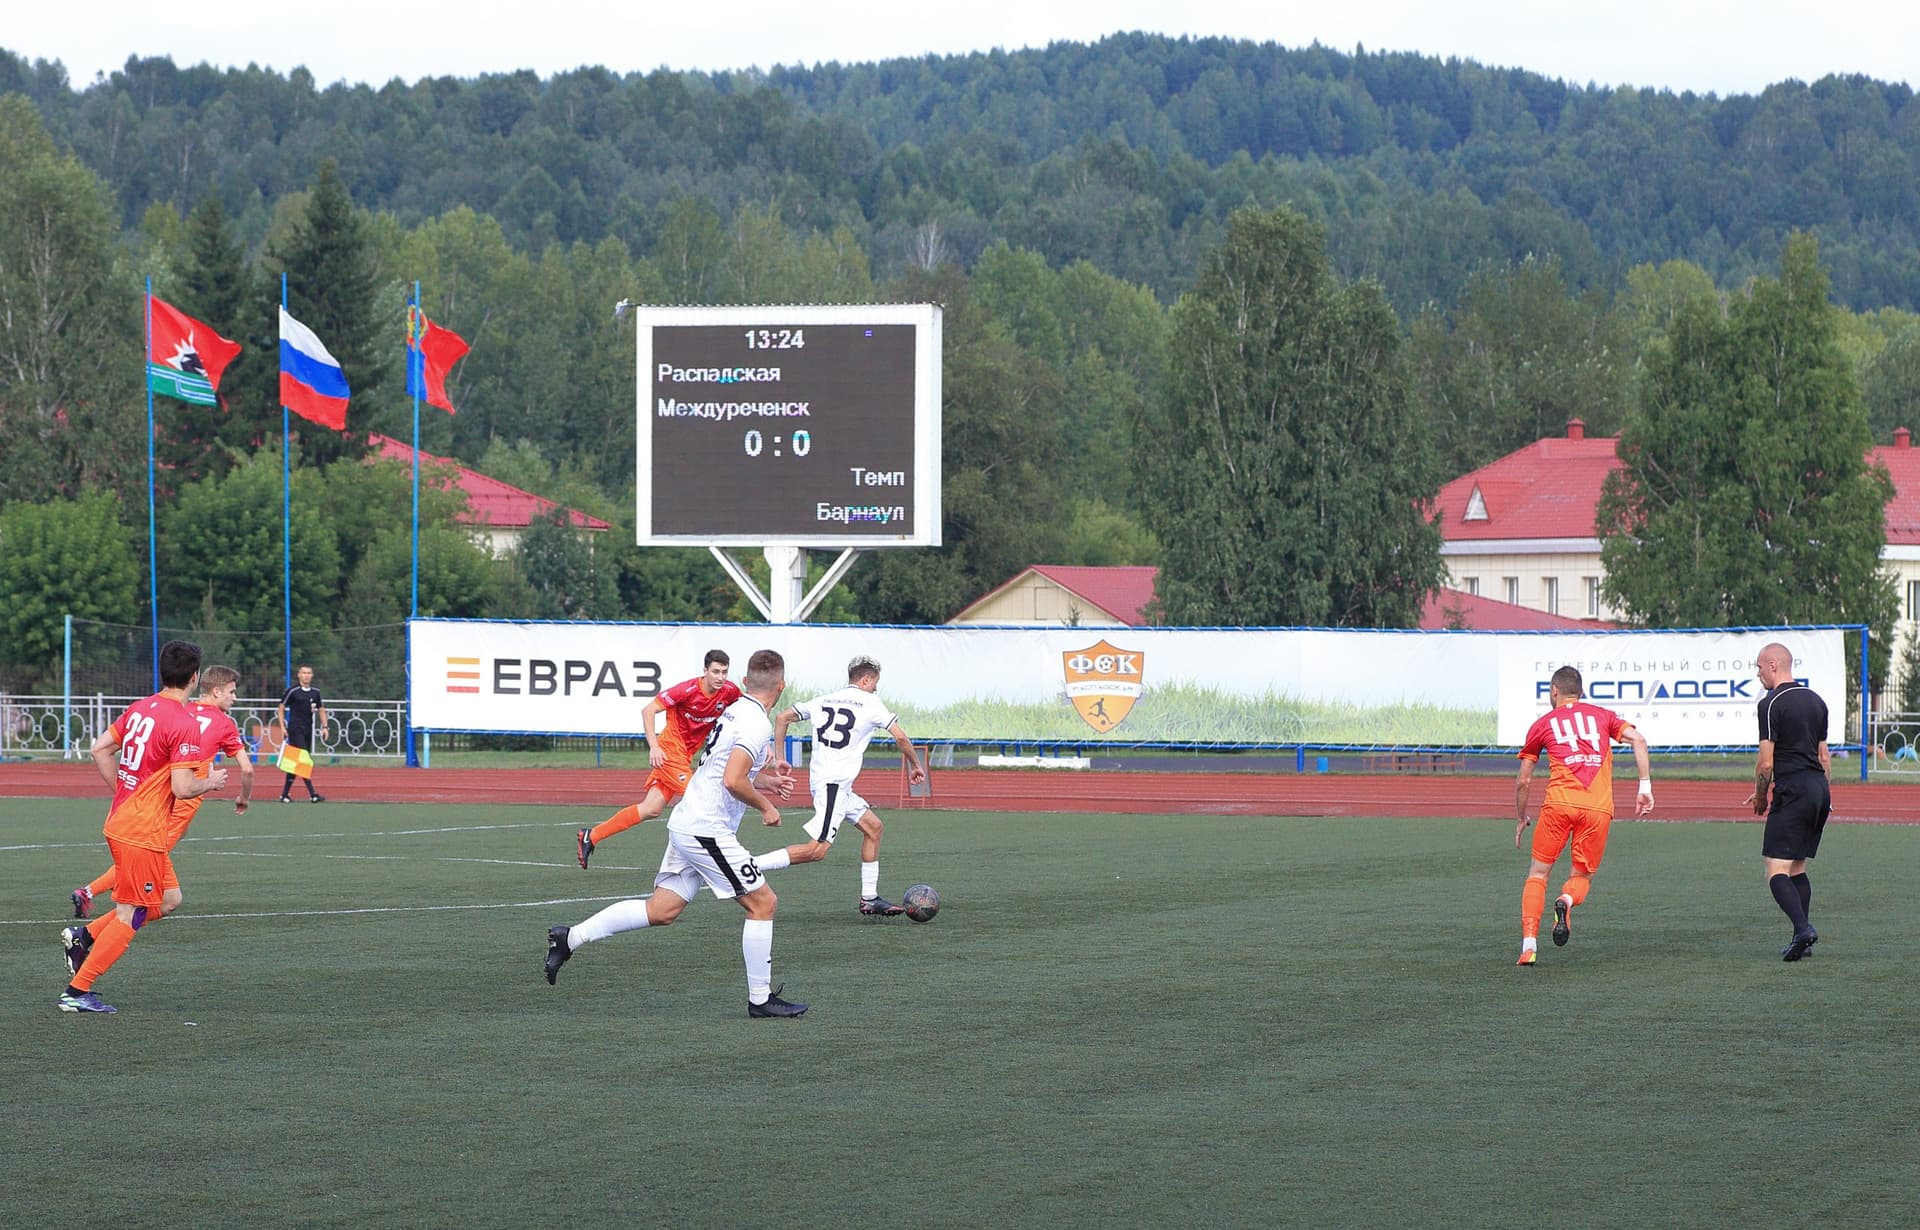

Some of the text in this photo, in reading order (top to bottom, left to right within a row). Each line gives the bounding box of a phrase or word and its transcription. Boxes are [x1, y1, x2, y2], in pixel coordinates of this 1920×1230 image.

[745, 329, 805, 349] 13:24
[658, 364, 781, 383] Распадская
[658, 398, 811, 421] Междуреченск
[851, 468, 905, 486] Темп
[816, 502, 905, 524] Барнаул
[1068, 654, 1139, 674] ФСК
[1702, 658, 1803, 671] СПОНР
[494, 658, 662, 697] ЕВРАЗ
[816, 706, 857, 750] 23
[1550, 712, 1600, 752] 44
[119, 711, 156, 772] 23
